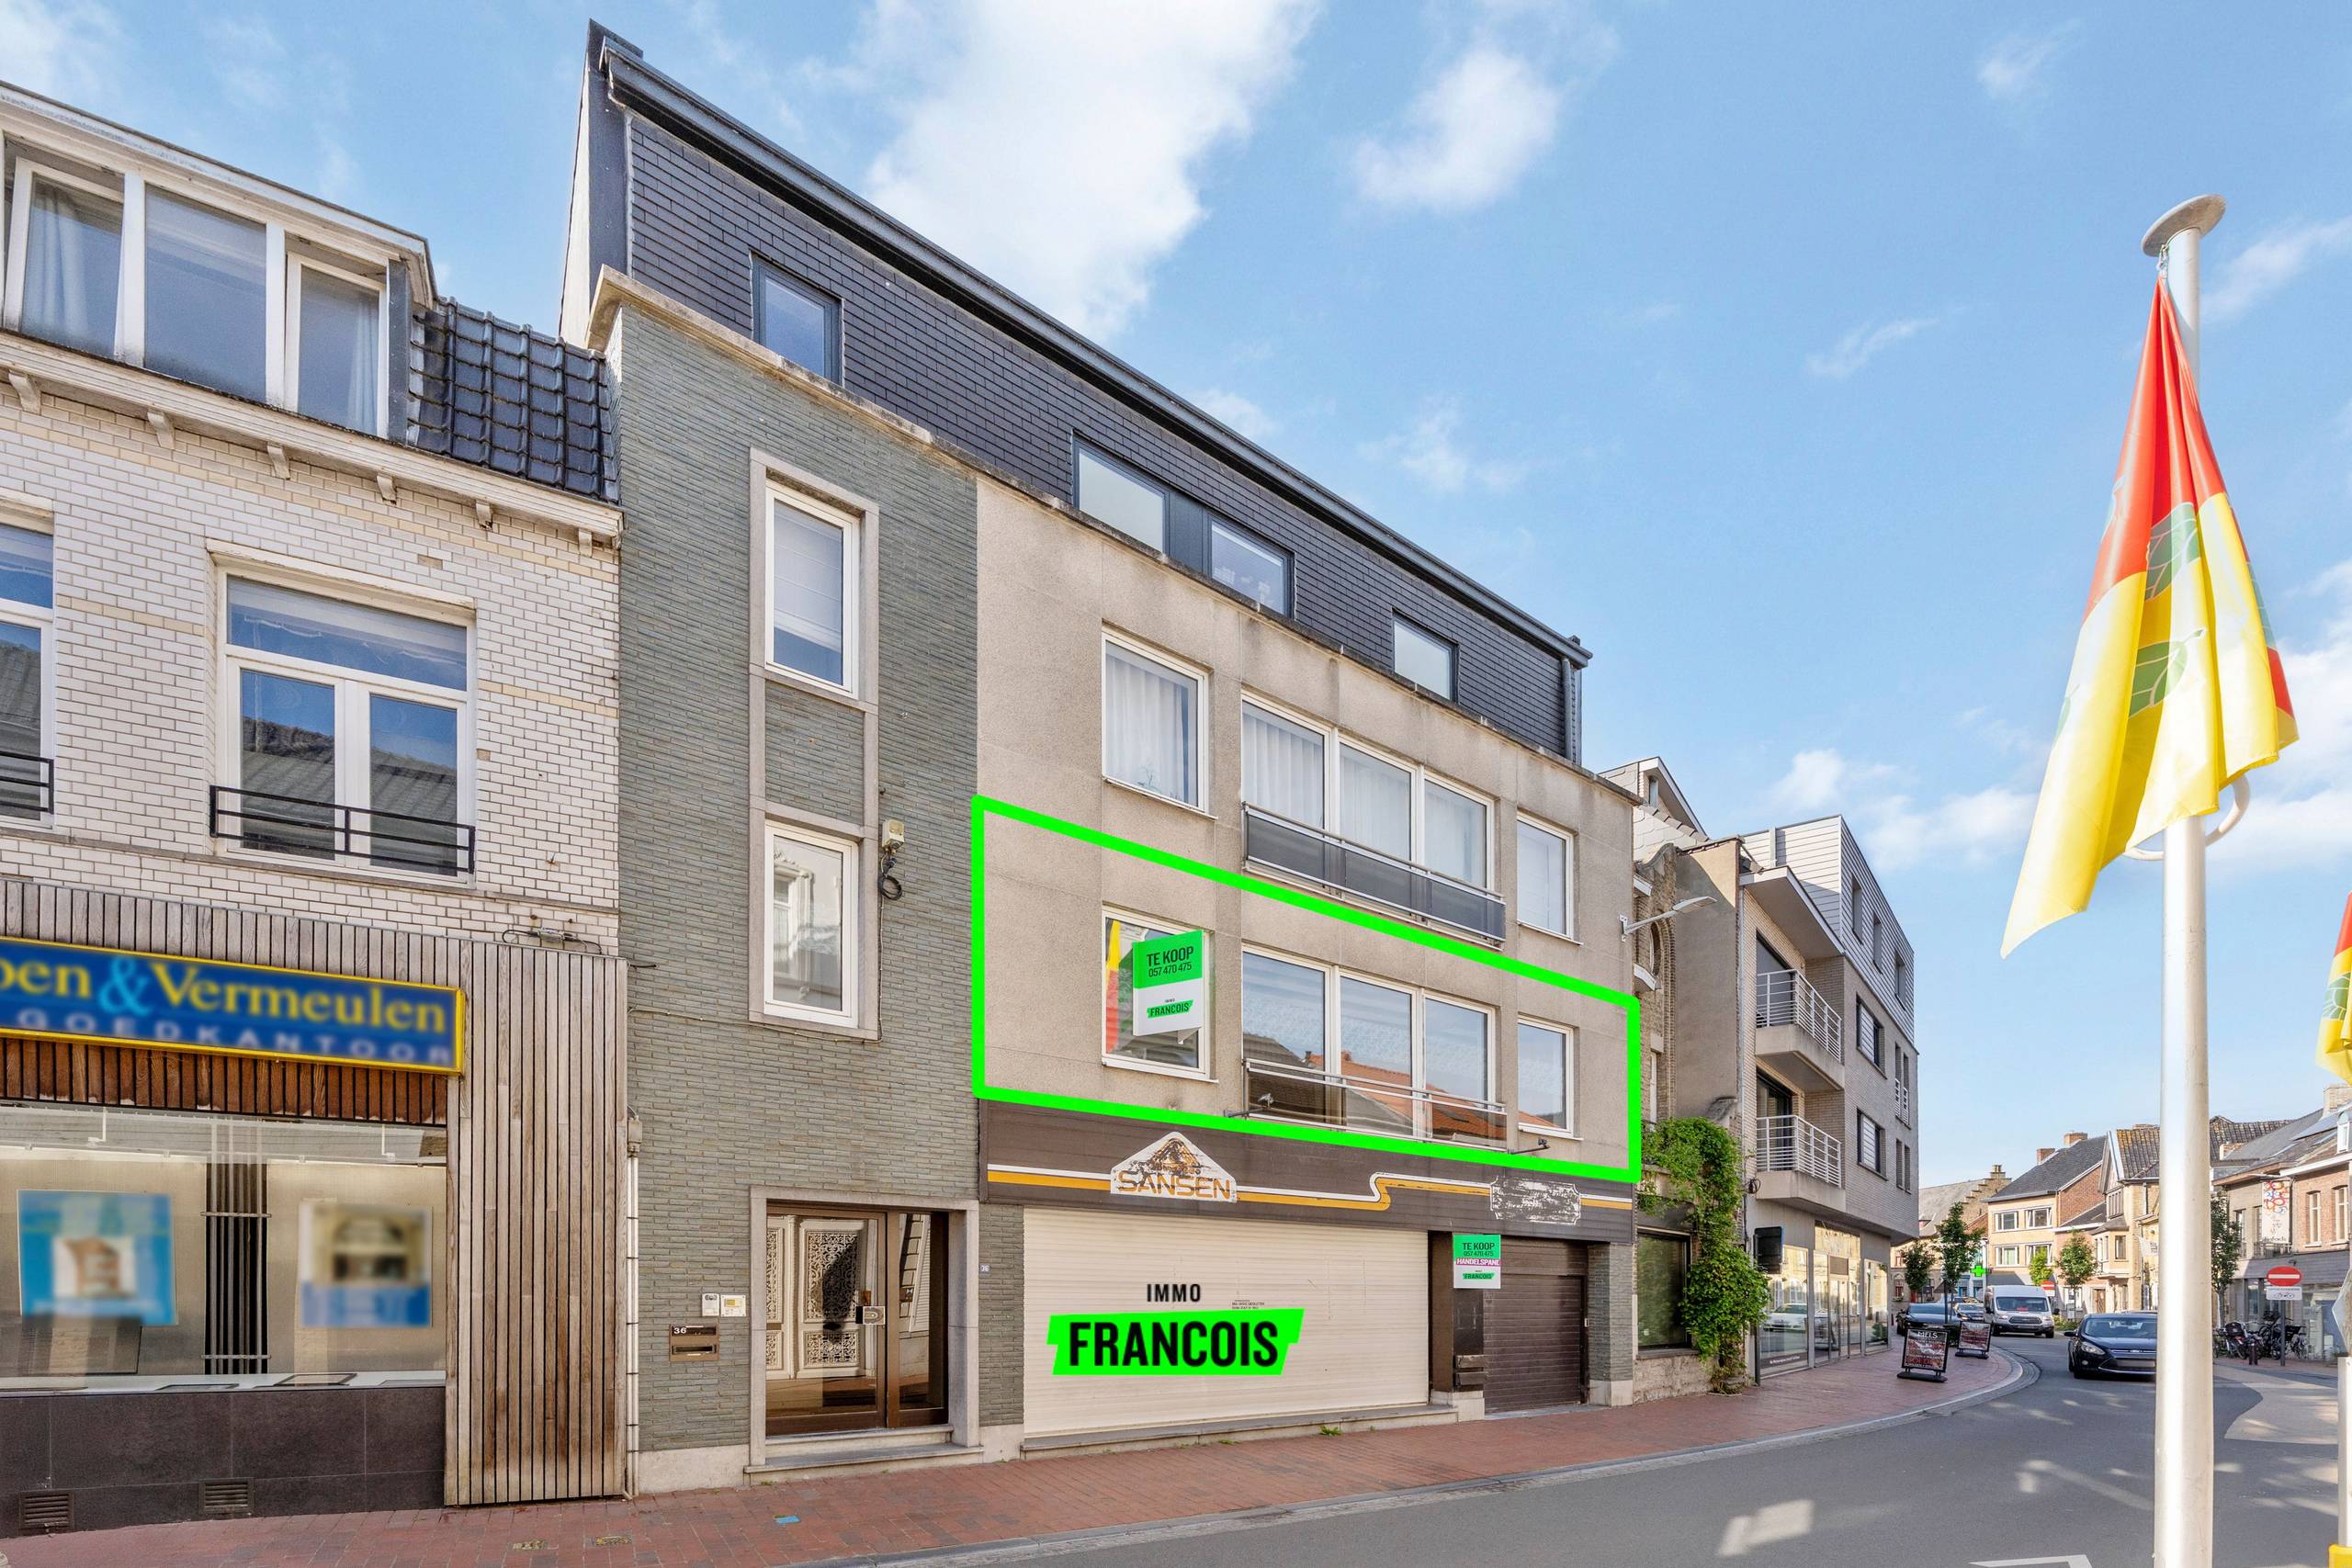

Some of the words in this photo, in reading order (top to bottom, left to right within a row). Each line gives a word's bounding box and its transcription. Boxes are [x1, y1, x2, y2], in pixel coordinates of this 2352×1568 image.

[1147, 952, 1160, 967] TE
[1162, 946, 1193, 964] KOOP
[1148, 966, 1161, 977] 057
[1163, 964, 1177, 975] 470
[1178, 962, 1192, 972] 475
[150, 962, 447, 1034] Vermeulen
[1150, 1002, 1189, 1017] FRANCOIS
[1117, 1169, 1231, 1200] SANSEN
[1462, 1242, 1472, 1250] TE
[1473, 1242, 1495, 1250] KOOP
